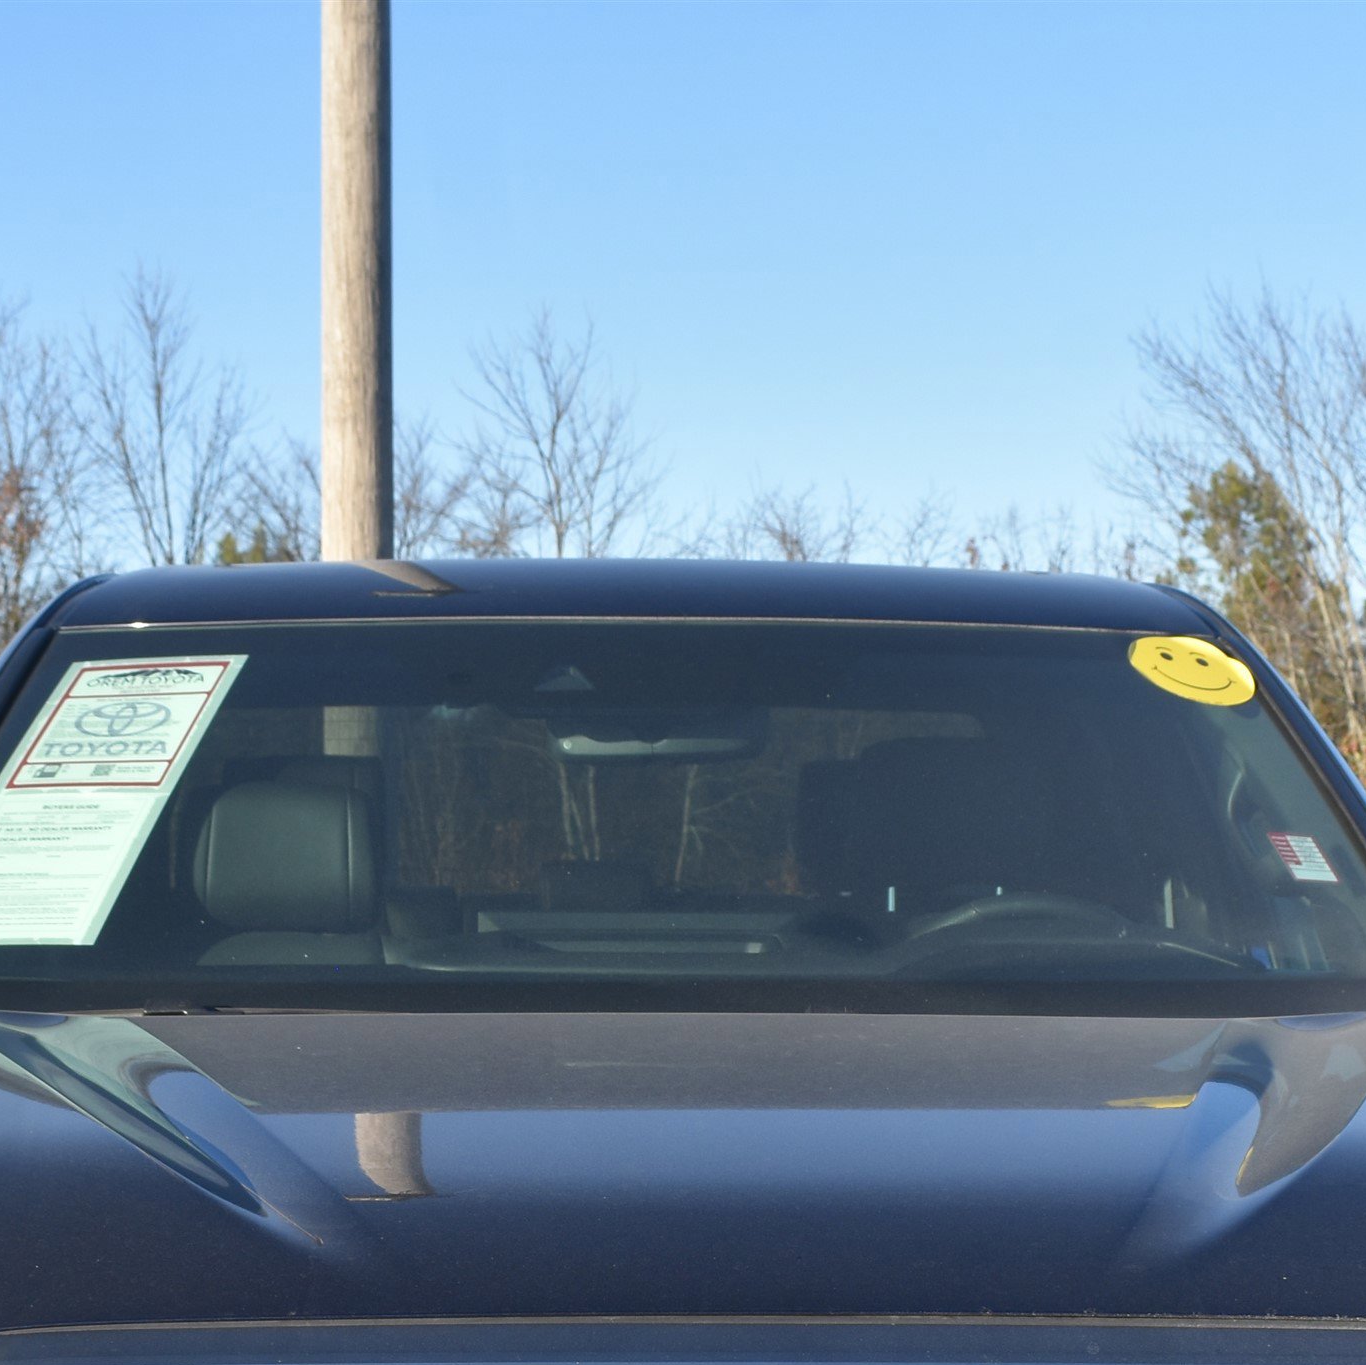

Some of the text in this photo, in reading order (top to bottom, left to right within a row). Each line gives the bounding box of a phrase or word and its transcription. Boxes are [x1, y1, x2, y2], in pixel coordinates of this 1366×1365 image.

[86, 673, 205, 688] OREM TOYOTA
[43, 740, 168, 757] TOYOTA
